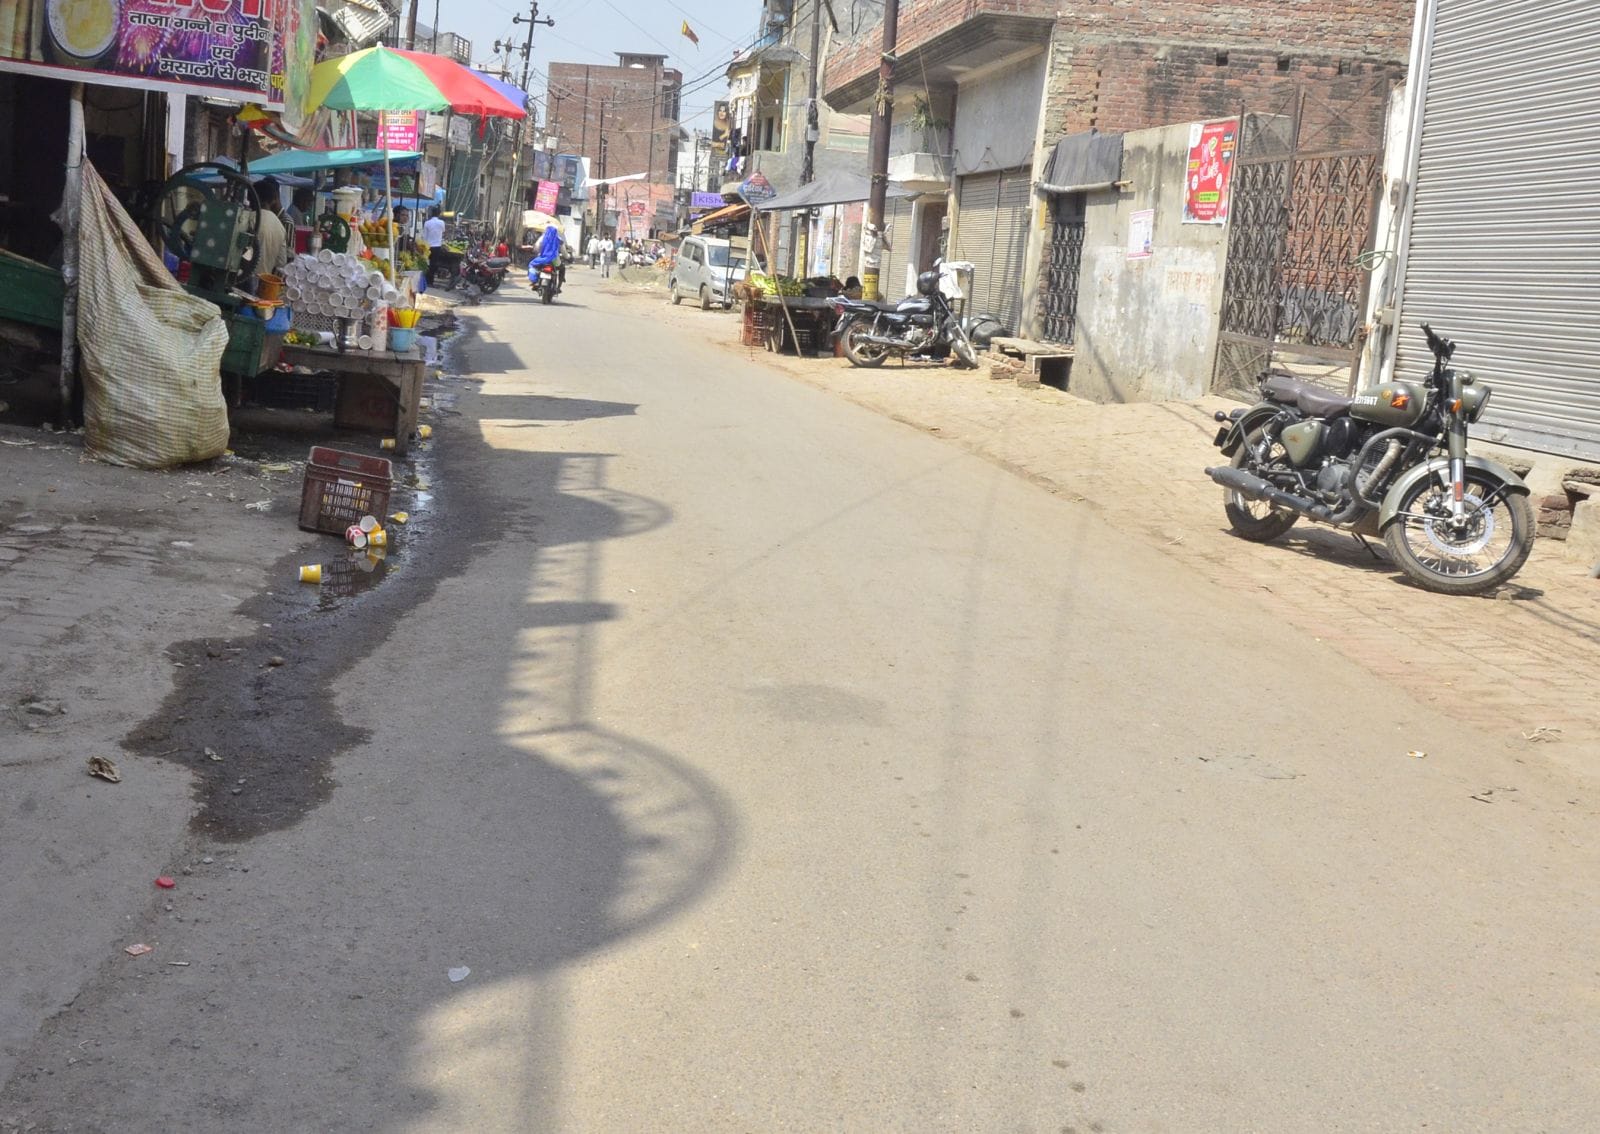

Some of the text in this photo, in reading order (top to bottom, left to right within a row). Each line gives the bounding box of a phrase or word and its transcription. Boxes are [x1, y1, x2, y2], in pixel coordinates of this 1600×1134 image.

[128, 11, 171, 28] ताजा
[174, 16, 213, 33] गन्ने
[216, 22, 229, 35] व
[211, 44, 239, 60] एवं
[160, 58, 271, 91] मसालों से भरपू
